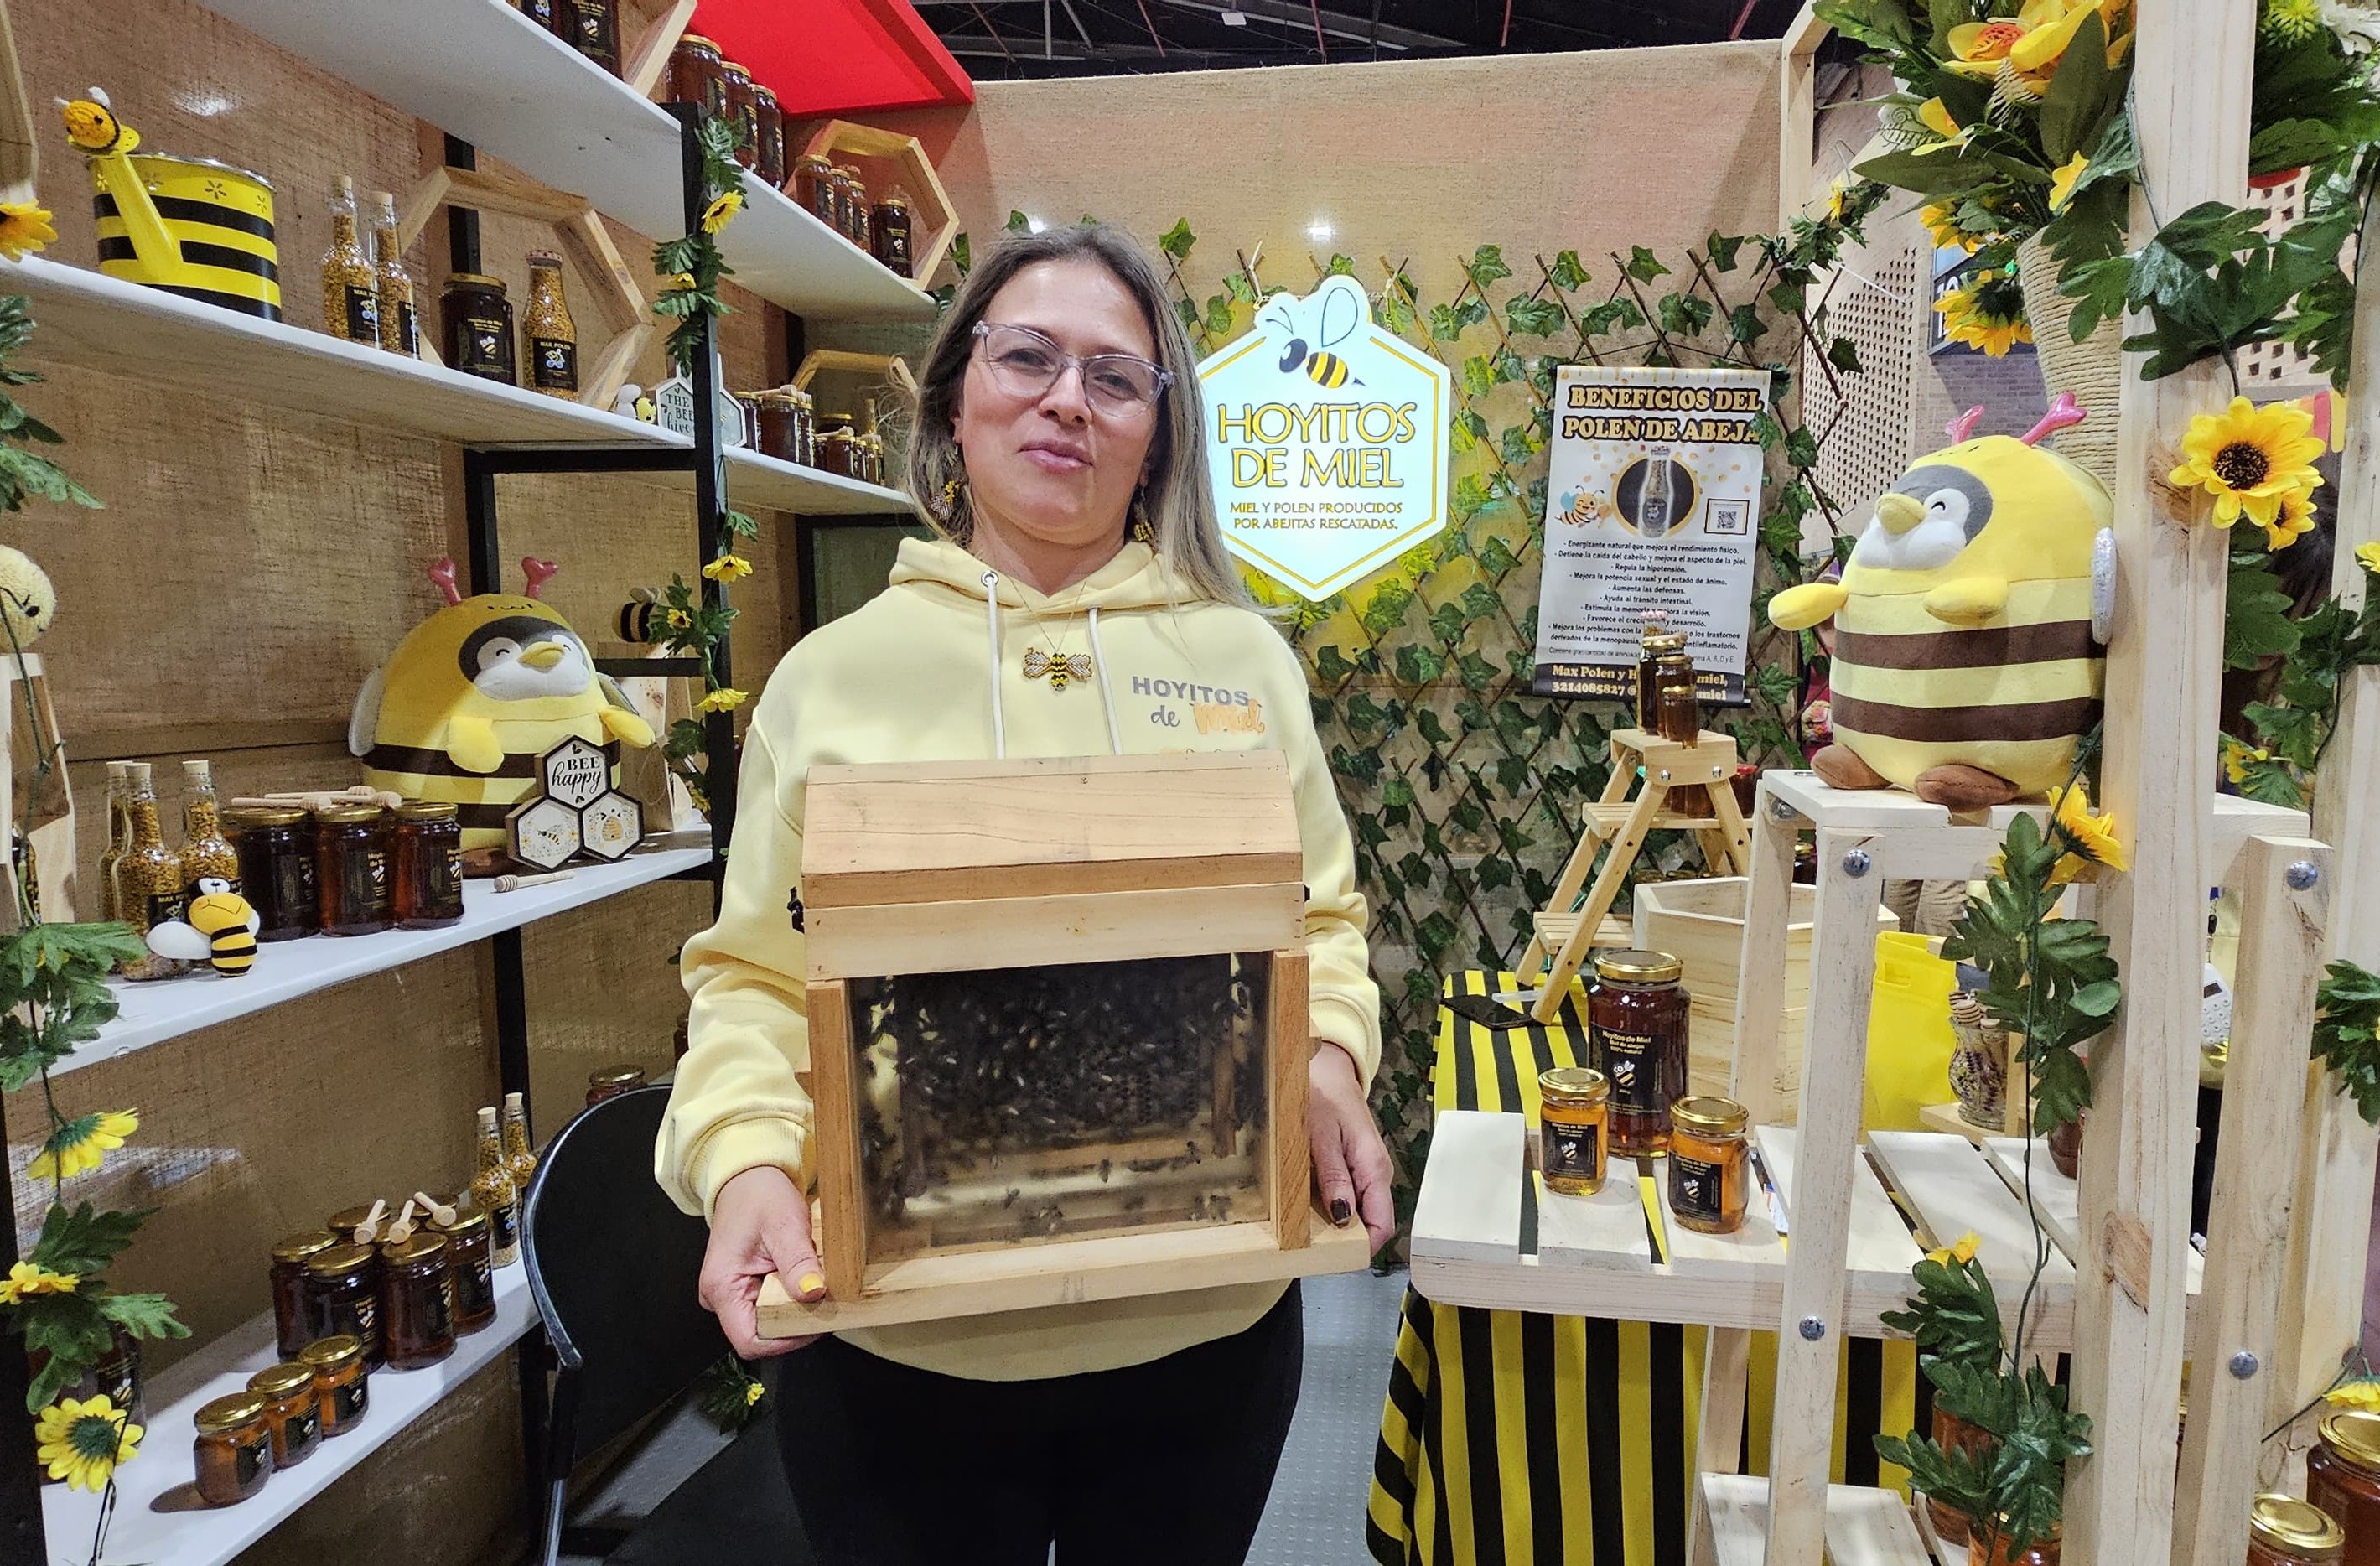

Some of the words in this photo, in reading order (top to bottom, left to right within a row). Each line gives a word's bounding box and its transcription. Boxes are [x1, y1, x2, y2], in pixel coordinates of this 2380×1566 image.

[666, 393, 689, 407] THE
[1569, 386, 1711, 411] BENEFICIOS
[1714, 388, 1762, 412] DEL
[676, 407, 694, 422] BEE
[667, 412, 690, 433] hive
[1218, 402, 1417, 443] HOYITOS
[1563, 417, 1641, 439] POLEN
[1644, 419, 1678, 441] DE
[1231, 448, 1288, 488] DE
[1300, 448, 1404, 488] MIEL
[1230, 502, 1259, 513] MIEL
[1262, 502, 1270, 513] Y
[1274, 502, 1314, 514] POLEN
[1319, 502, 1403, 514] PRODUCIDOS
[1234, 518, 1260, 529] POR
[1263, 518, 1315, 530] ABEJITAS
[1320, 518, 1398, 530] RESCATADAS.
[1568, 540, 1605, 549] Energizante
[1615, 563, 1637, 573] Regula
[1574, 572, 1595, 580] Mejora
[1604, 594, 1623, 603] Ayuda
[1587, 614, 1616, 623] Favorece
[1587, 625, 1620, 634] problemas
[1551, 634, 1581, 642] derivados
[1553, 665, 1579, 677] Max
[1580, 666, 1615, 679] Polen
[1617, 671, 1626, 681] y
[1132, 676, 1249, 707] HOYITOS
[1552, 682, 1626, 697] 3214085827
[1150, 704, 1180, 728] de
[567, 756, 600, 770] BEE
[552, 761, 601, 795] happy
